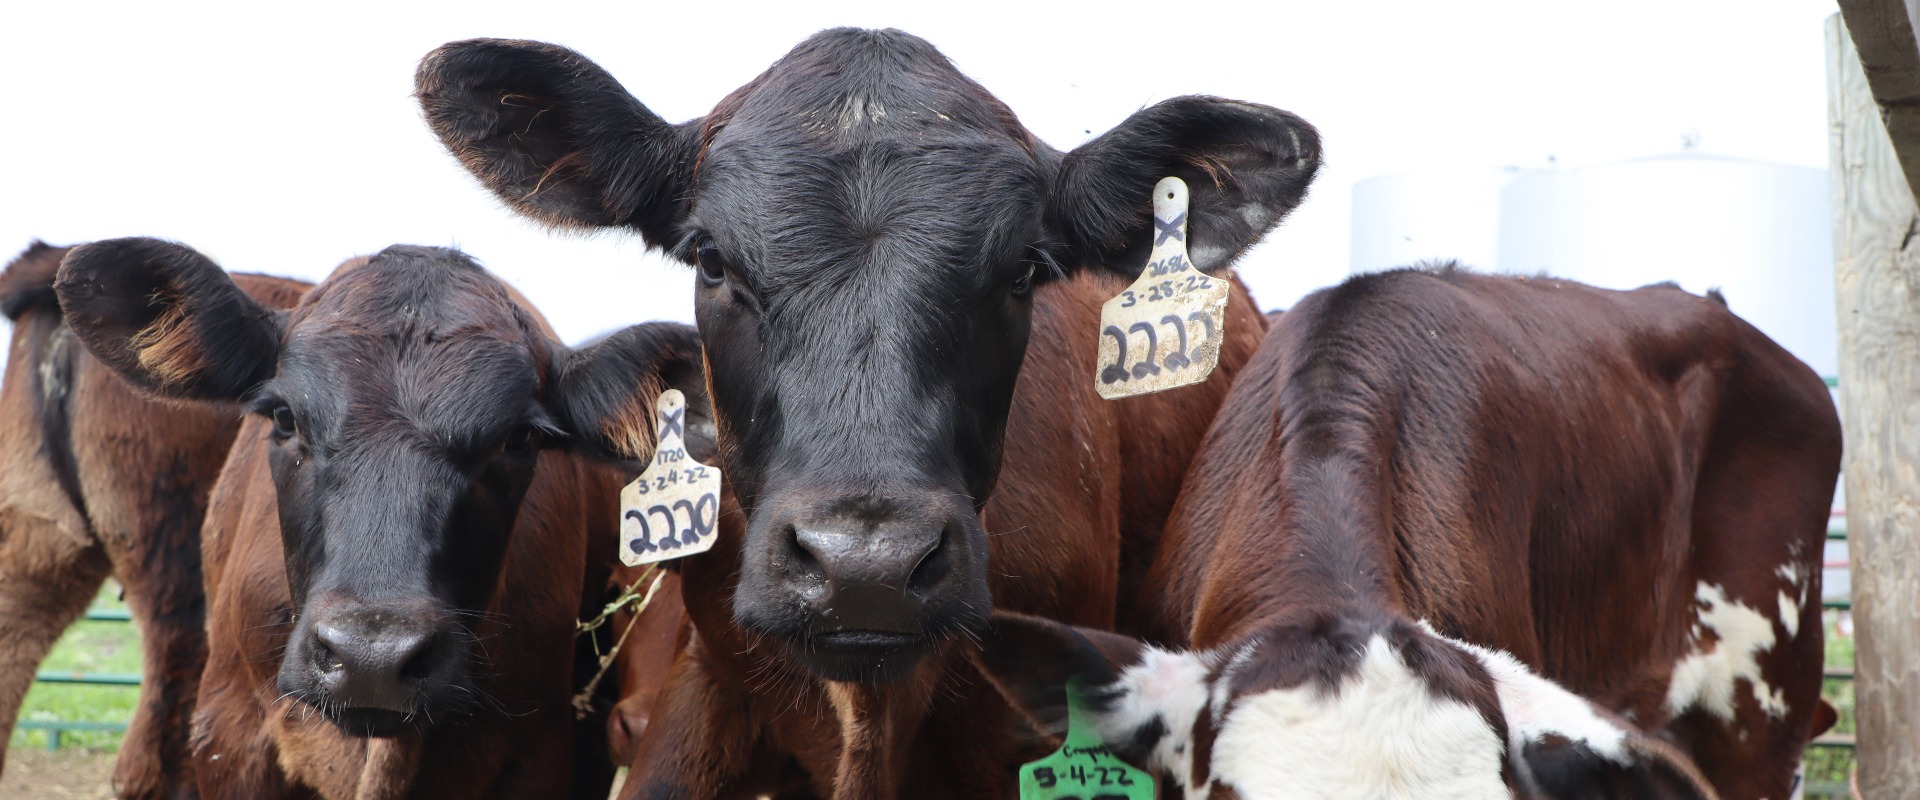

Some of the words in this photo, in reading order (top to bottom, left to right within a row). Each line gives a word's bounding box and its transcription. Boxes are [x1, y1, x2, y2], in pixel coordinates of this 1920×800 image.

[1148, 255, 1189, 278] 2686
[1121, 275, 1212, 307] 3-28-22
[657, 447, 684, 465] 1720
[638, 467, 709, 495] 3-24-22
[625, 493, 717, 554] 2220
